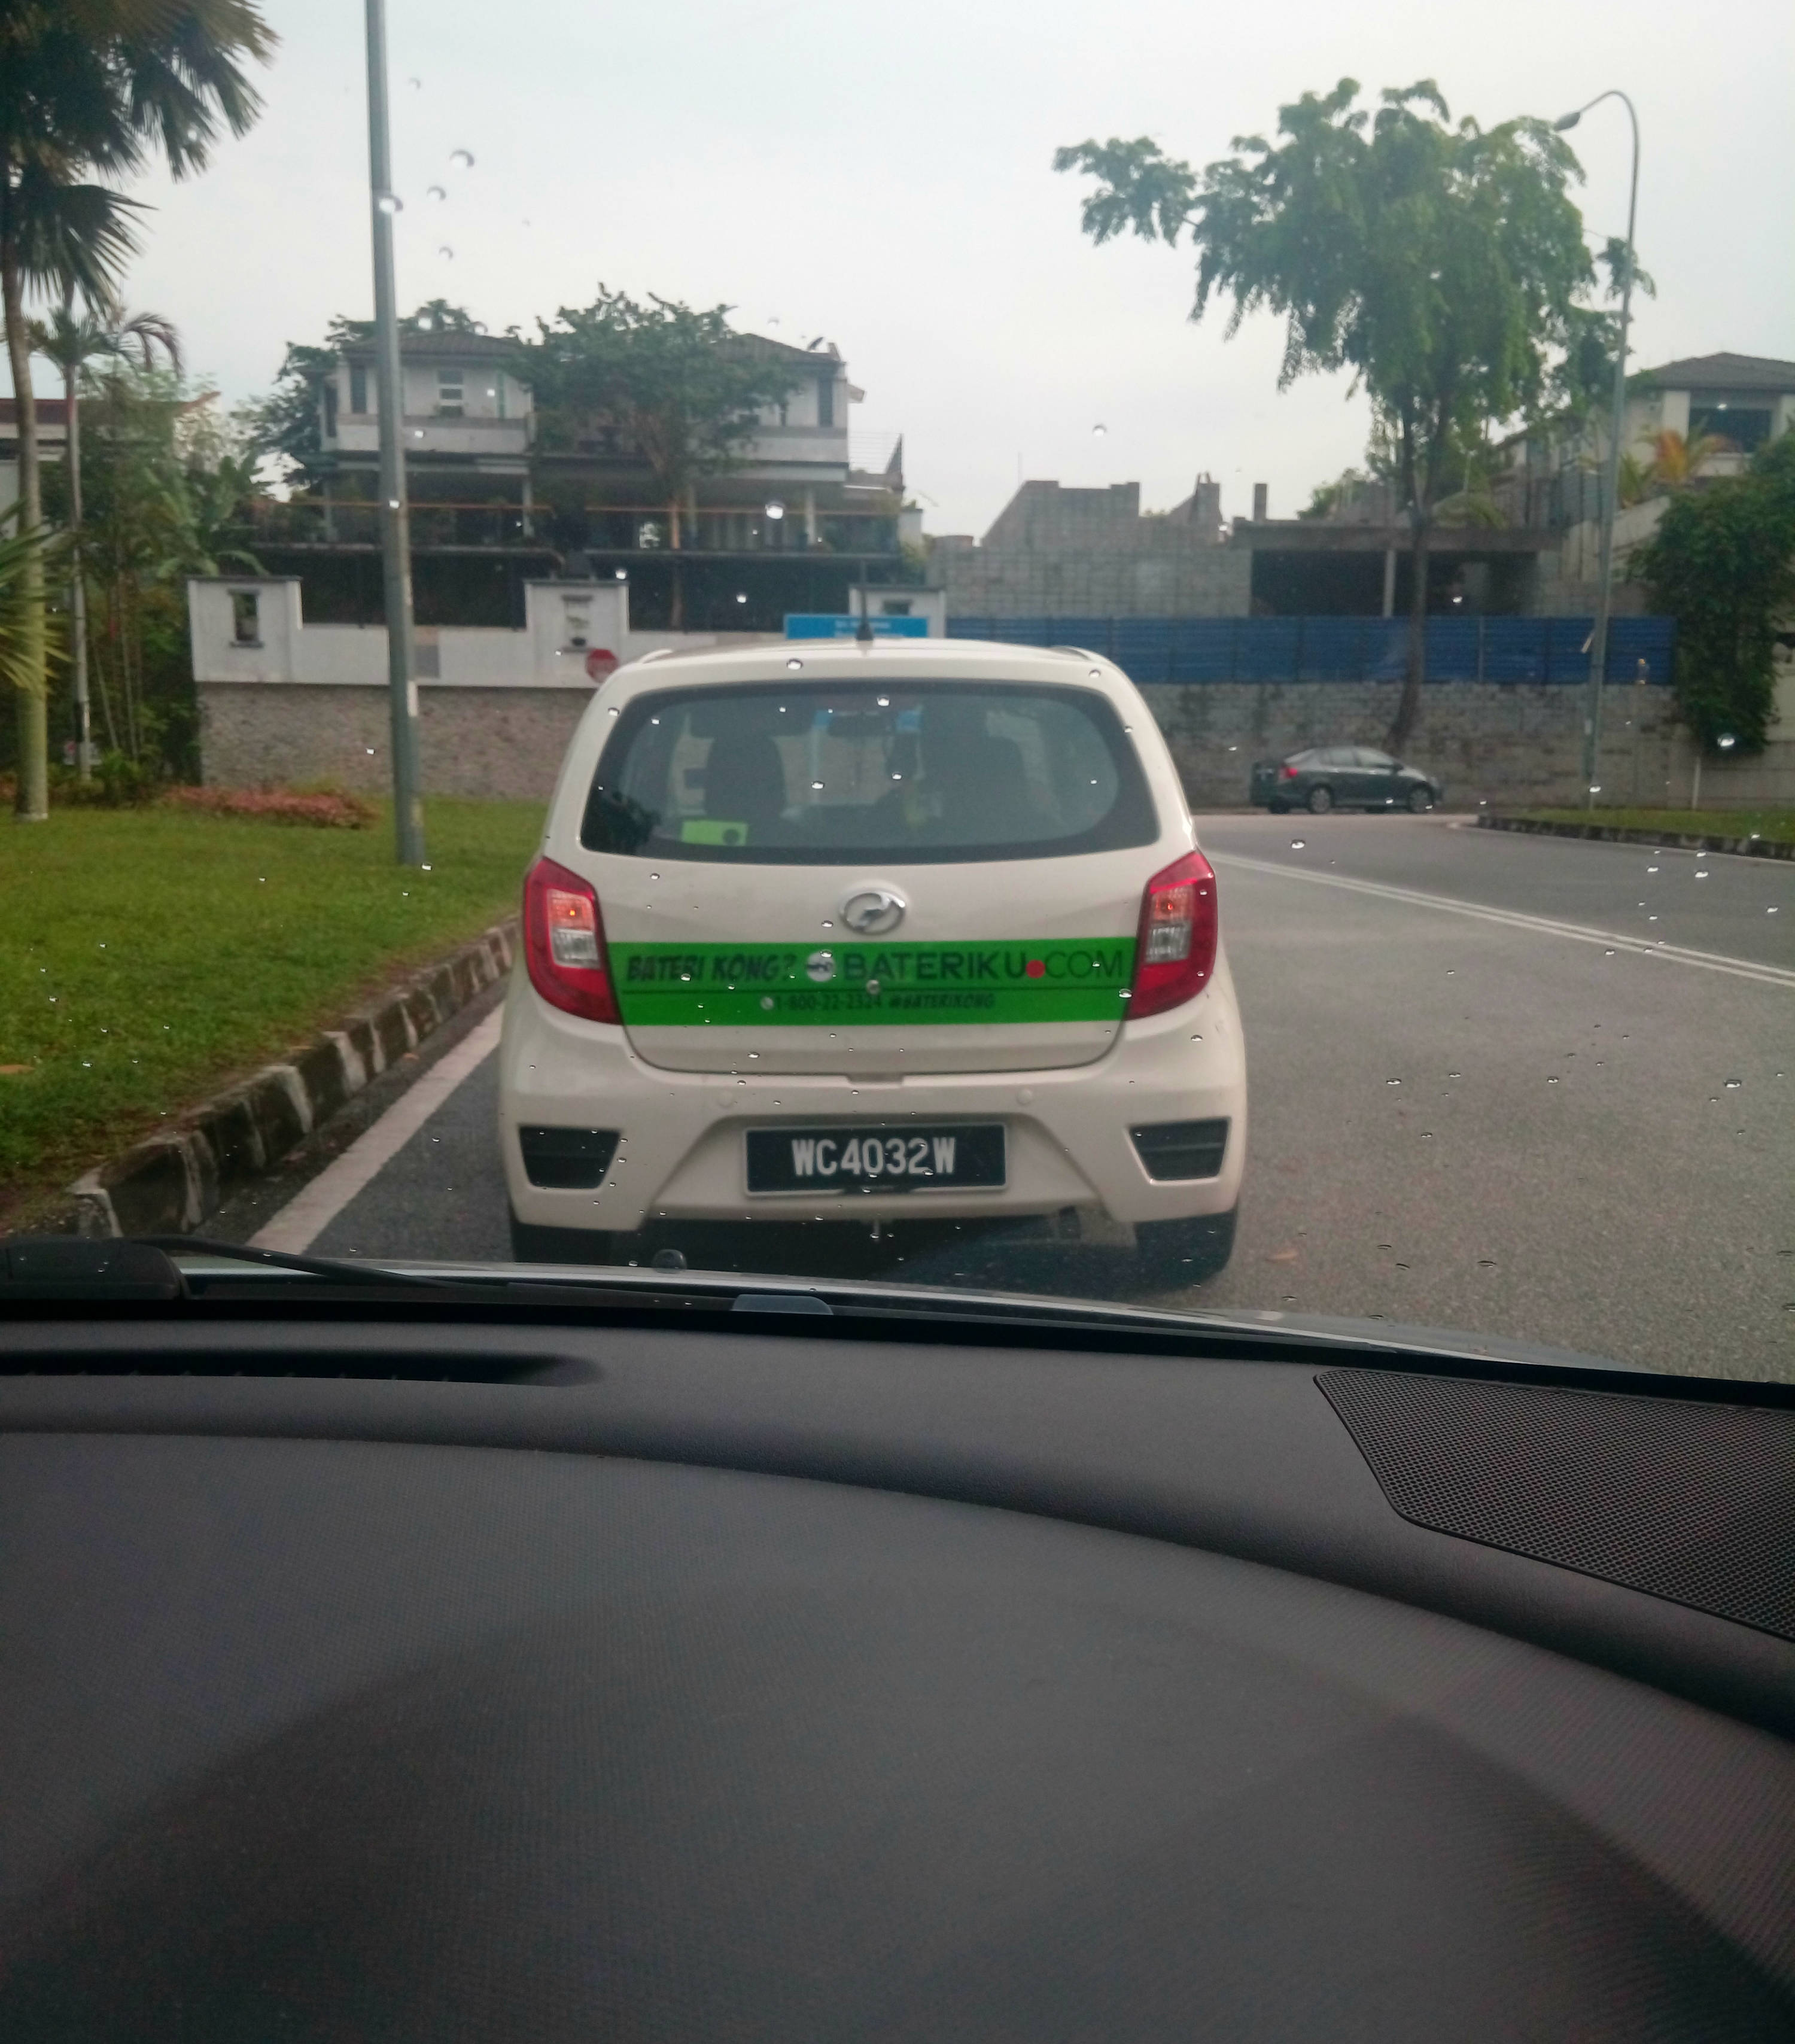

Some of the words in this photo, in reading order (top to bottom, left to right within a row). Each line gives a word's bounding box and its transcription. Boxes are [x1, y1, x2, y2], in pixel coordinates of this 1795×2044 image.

[627, 954, 705, 982] BATERI
[711, 953, 797, 982] KONG?
[843, 950, 1123, 980] BATERIKU.COM
[792, 1137, 956, 1176] WC4032W
